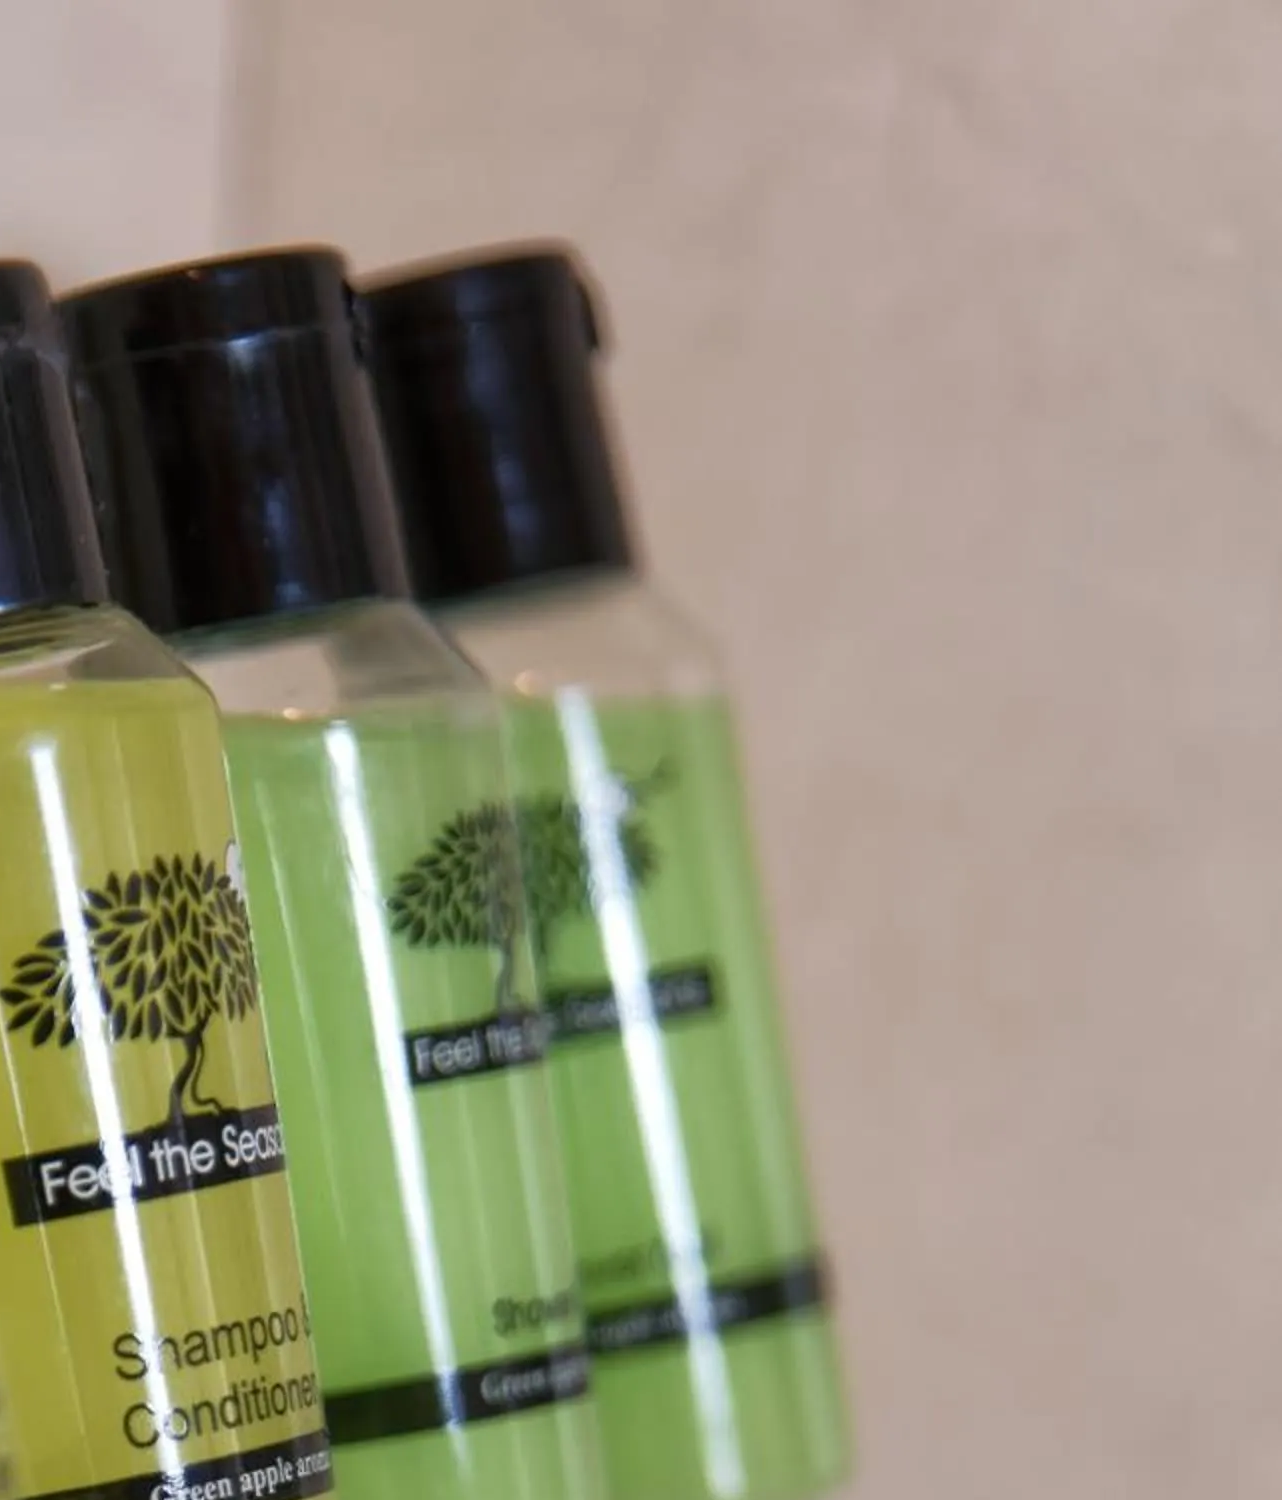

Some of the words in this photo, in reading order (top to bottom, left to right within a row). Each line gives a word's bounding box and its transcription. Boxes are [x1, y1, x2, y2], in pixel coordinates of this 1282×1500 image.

[415, 1030, 480, 1077] Feel
[149, 1139, 215, 1181] the
[240, 1457, 293, 1496] apple
